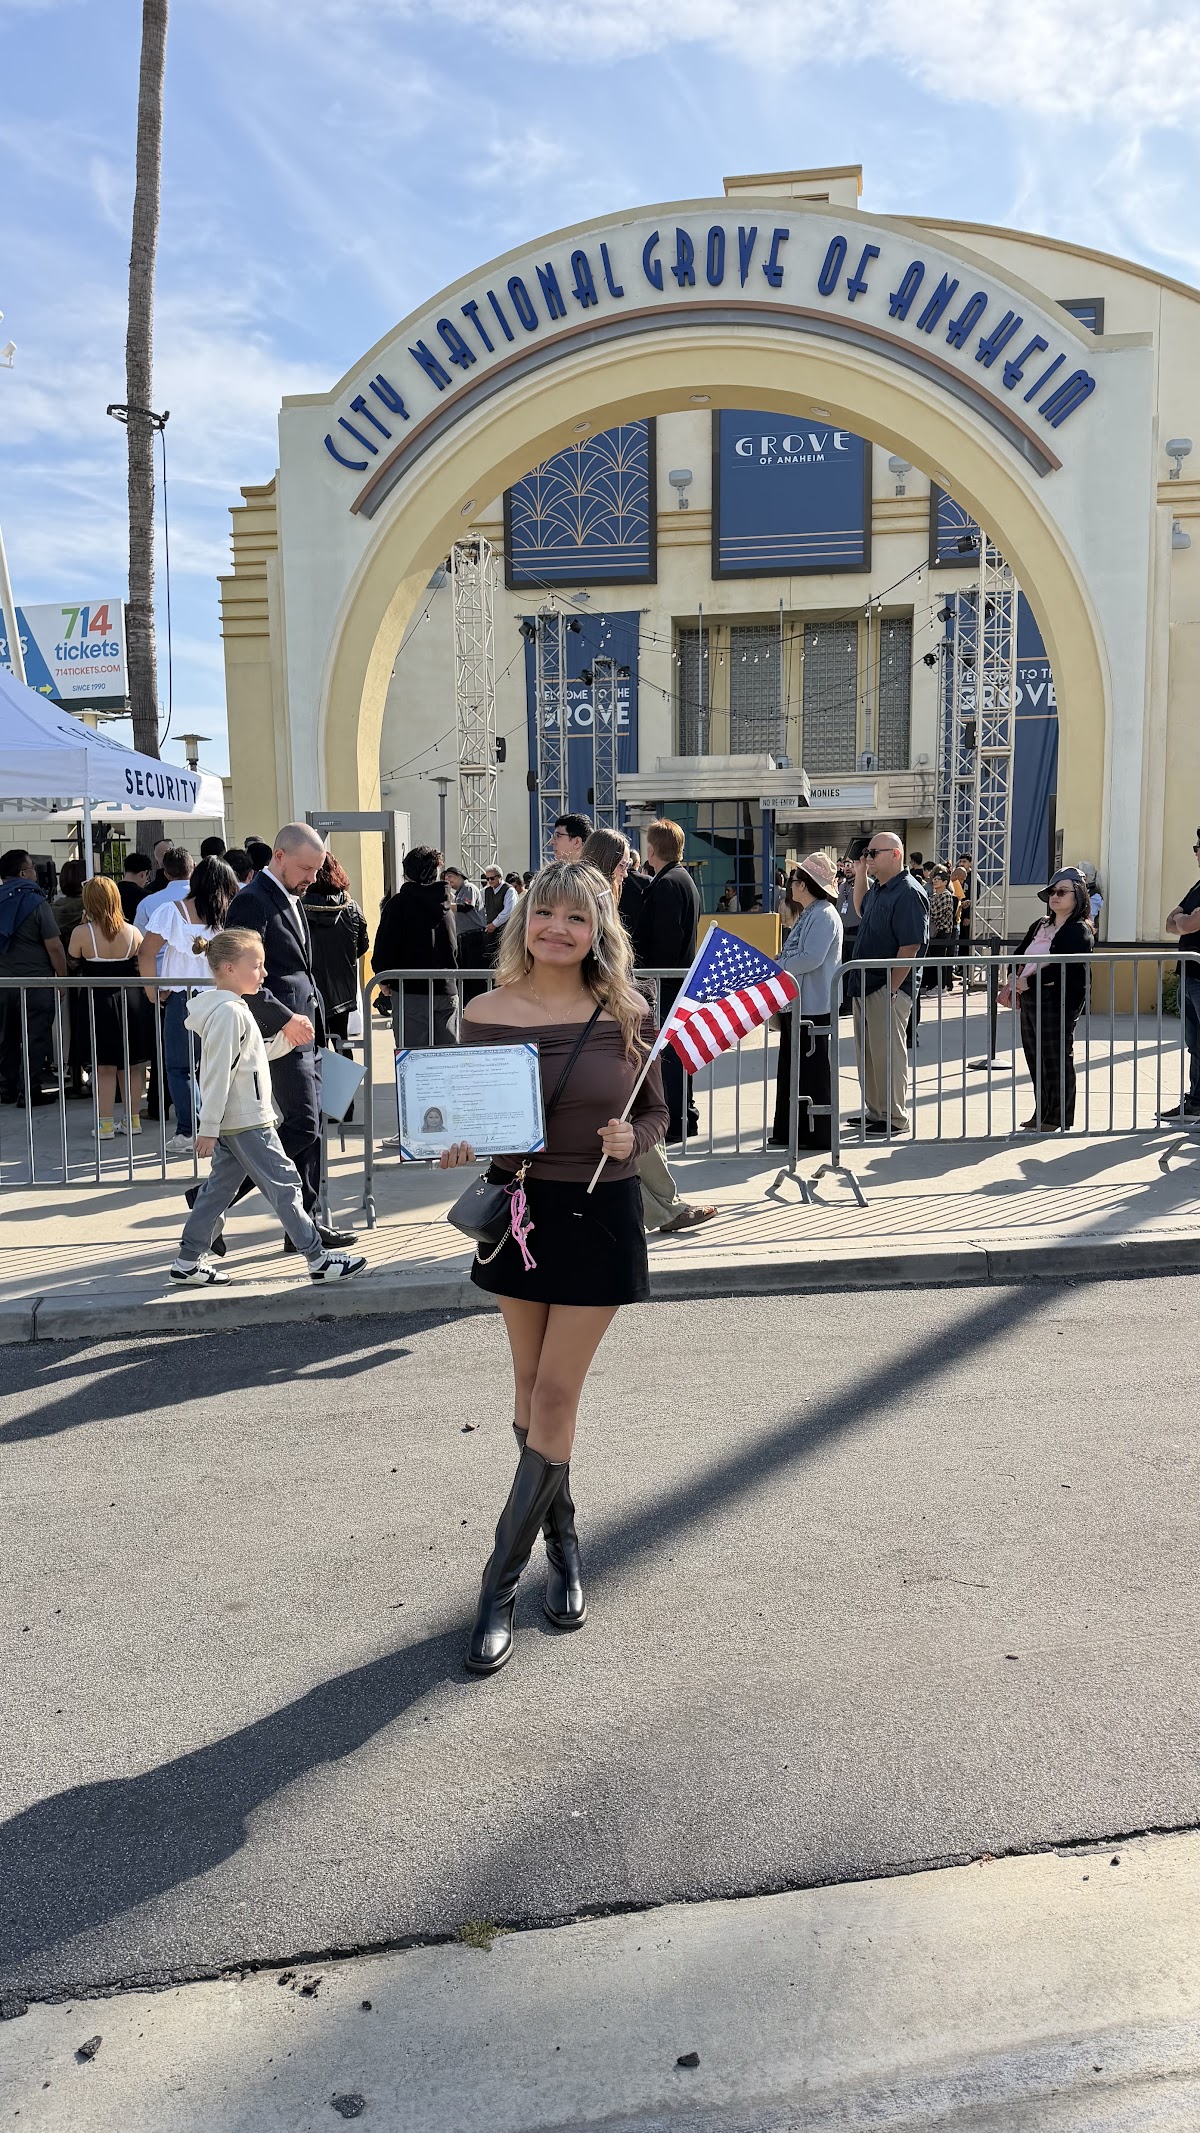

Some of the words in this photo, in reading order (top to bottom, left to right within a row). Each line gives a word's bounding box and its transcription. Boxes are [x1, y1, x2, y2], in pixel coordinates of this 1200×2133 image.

[323, 373, 410, 472] CITY
[407, 242, 625, 392] NATIONAL
[642, 225, 790, 292] GROVE
[818, 235, 881, 302] OF
[889, 260, 1096, 429] ANAHEIM
[735, 432, 850, 457] GROVE
[760, 457, 773, 465] OF
[777, 454, 825, 464] ANAHEIM
[61, 605, 112, 639] 714
[54, 639, 119, 661] tickets
[55, 665, 121, 676] 714TICKETS.COM
[1020, 669, 1037, 679] TO
[91, 683, 106, 691] 1990
[125, 768, 197, 804] SECURITY
[772, 799, 796, 807] RE-ENTRY
